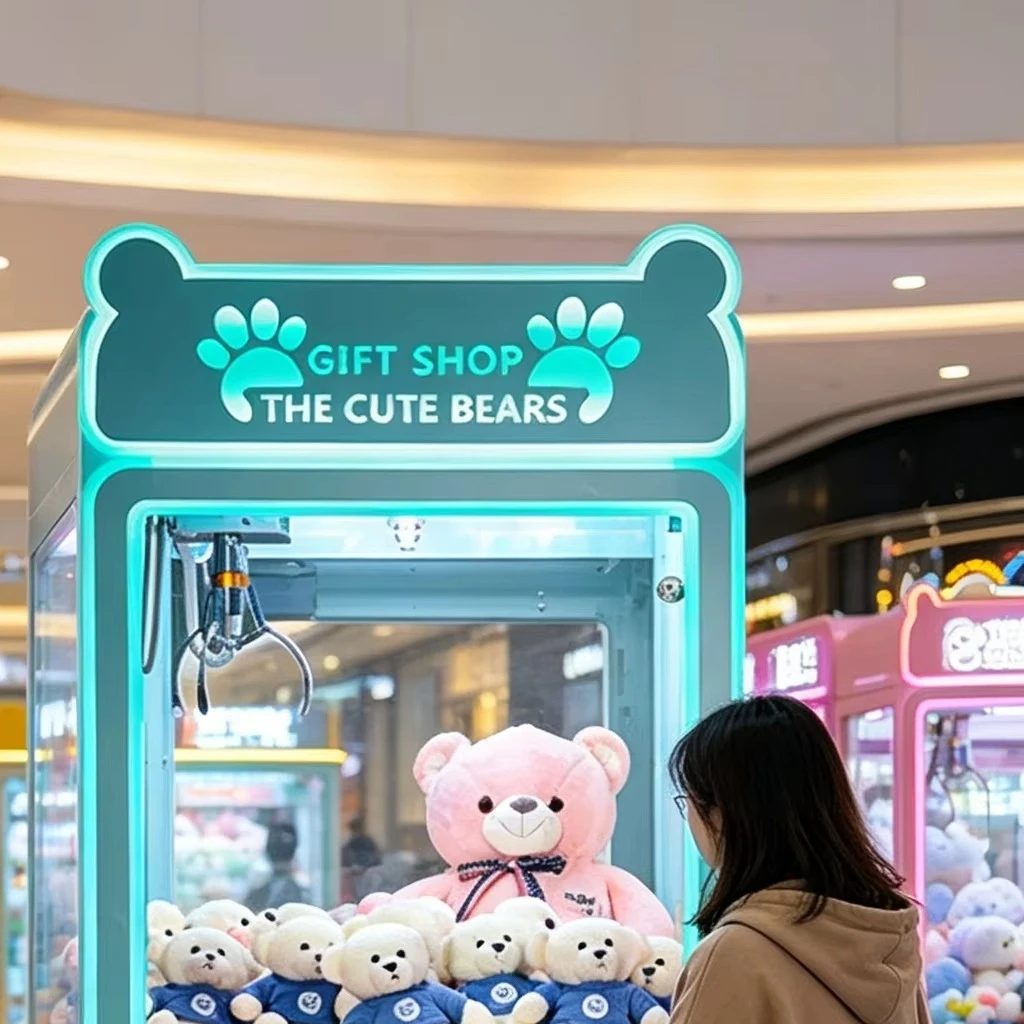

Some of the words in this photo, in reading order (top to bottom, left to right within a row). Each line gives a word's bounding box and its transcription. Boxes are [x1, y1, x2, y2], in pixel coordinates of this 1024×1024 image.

[307, 344, 398, 376] GIFT
[411, 344, 524, 377] SHOP
[260, 393, 334, 424] THE
[343, 393, 439, 424] CUTE
[450, 393, 568, 425] BEARS
